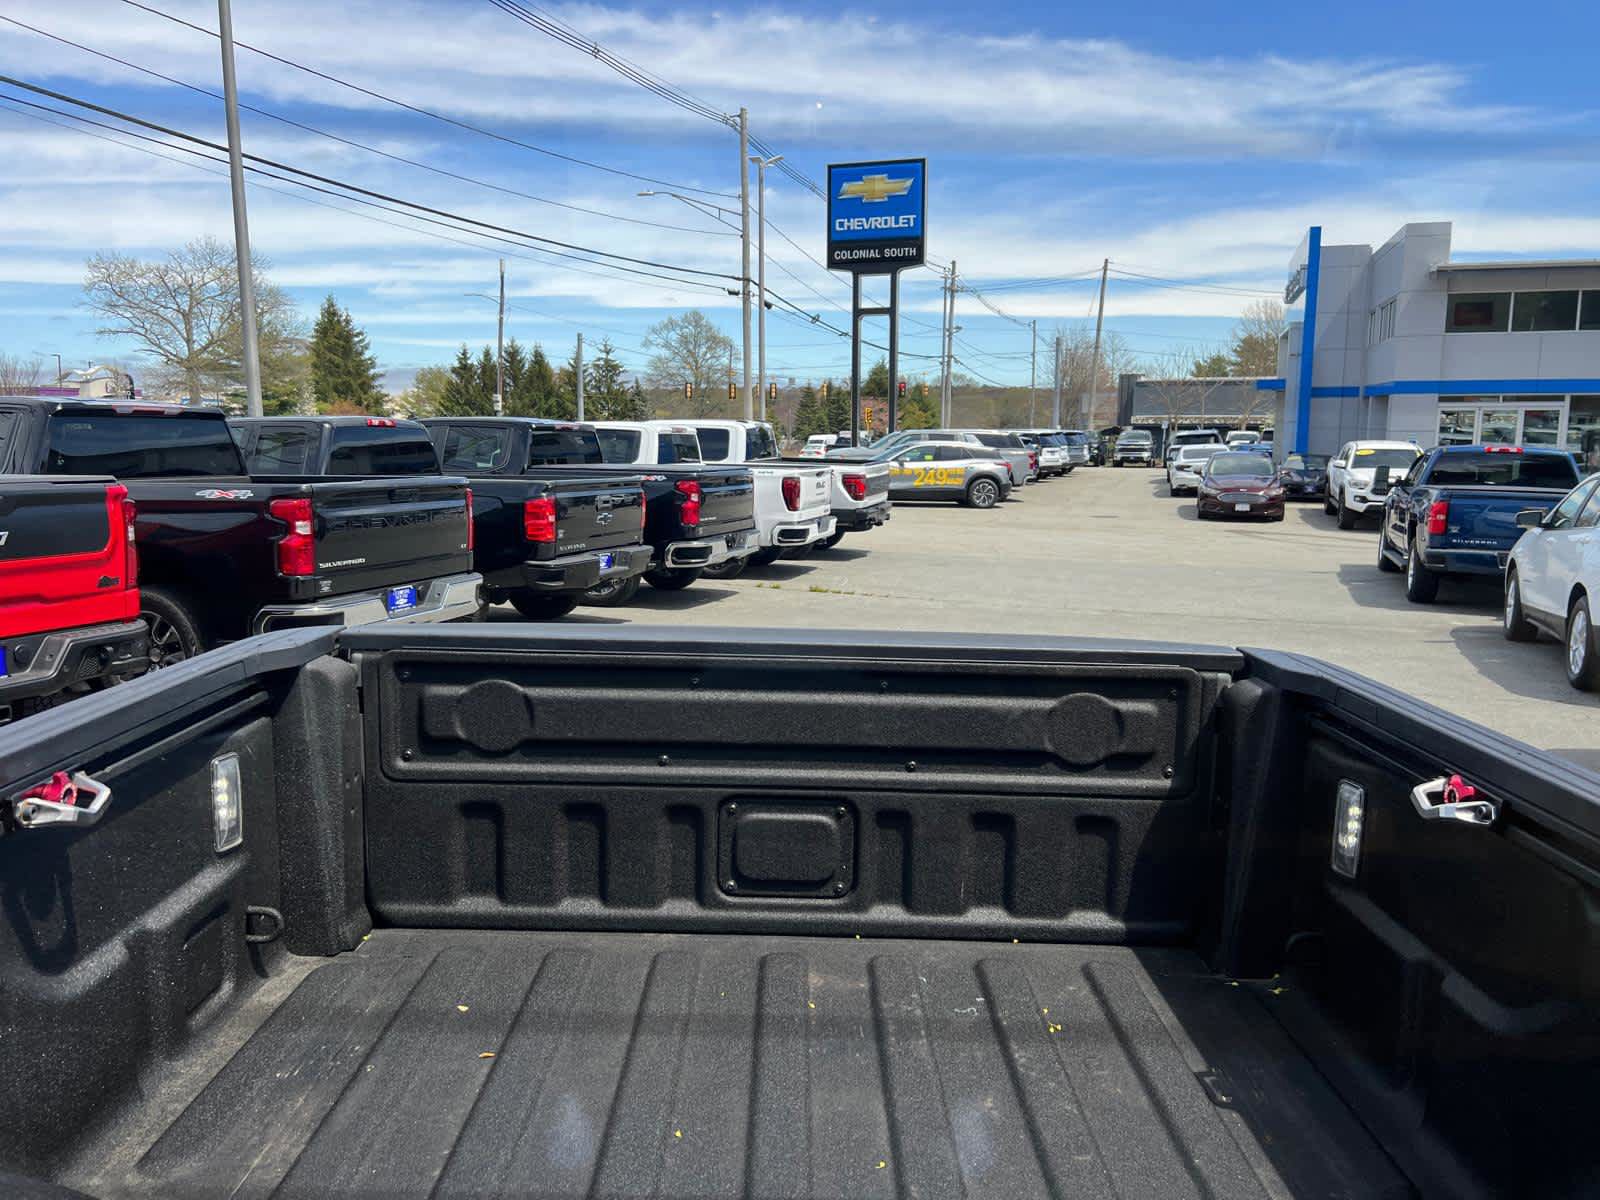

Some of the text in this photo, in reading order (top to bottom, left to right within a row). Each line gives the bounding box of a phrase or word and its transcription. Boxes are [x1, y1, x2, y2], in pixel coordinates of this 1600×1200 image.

[835, 215, 916, 231] CHEVROLET
[834, 247, 917, 260] COLONIAL SOUTH
